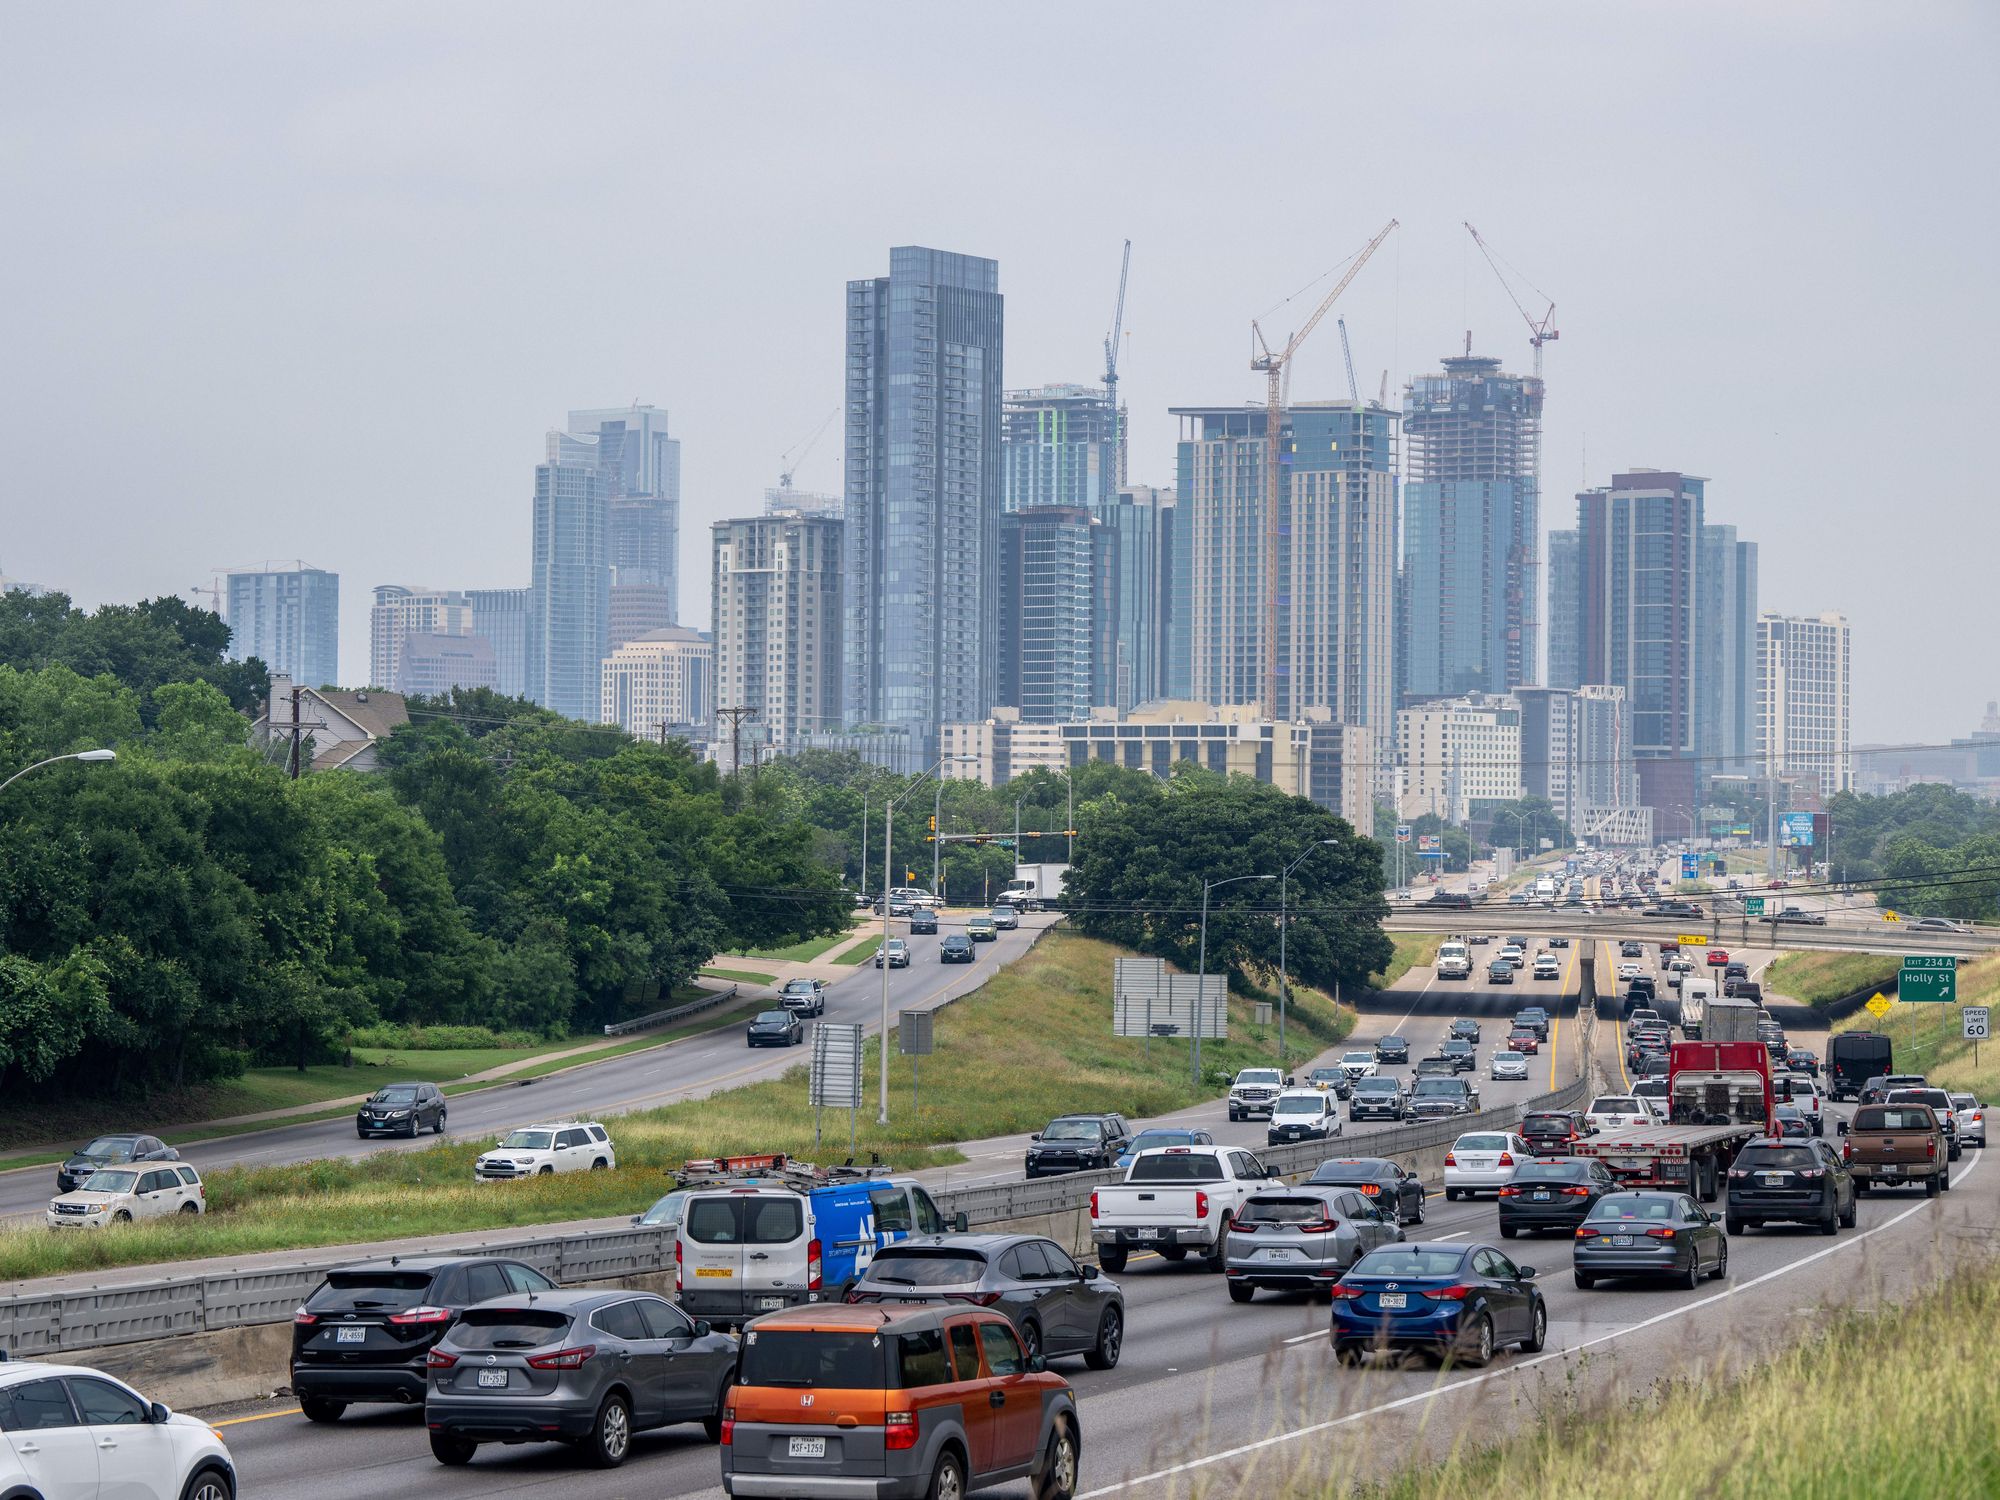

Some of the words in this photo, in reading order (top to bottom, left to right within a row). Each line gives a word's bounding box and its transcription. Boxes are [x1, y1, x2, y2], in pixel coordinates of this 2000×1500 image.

[1925, 958, 1943, 967] 234
[1945, 959, 1953, 967] A
[1905, 974, 1933, 984] Holly
[1938, 974, 1950, 982] St
[1967, 1025, 1985, 1035] 60
